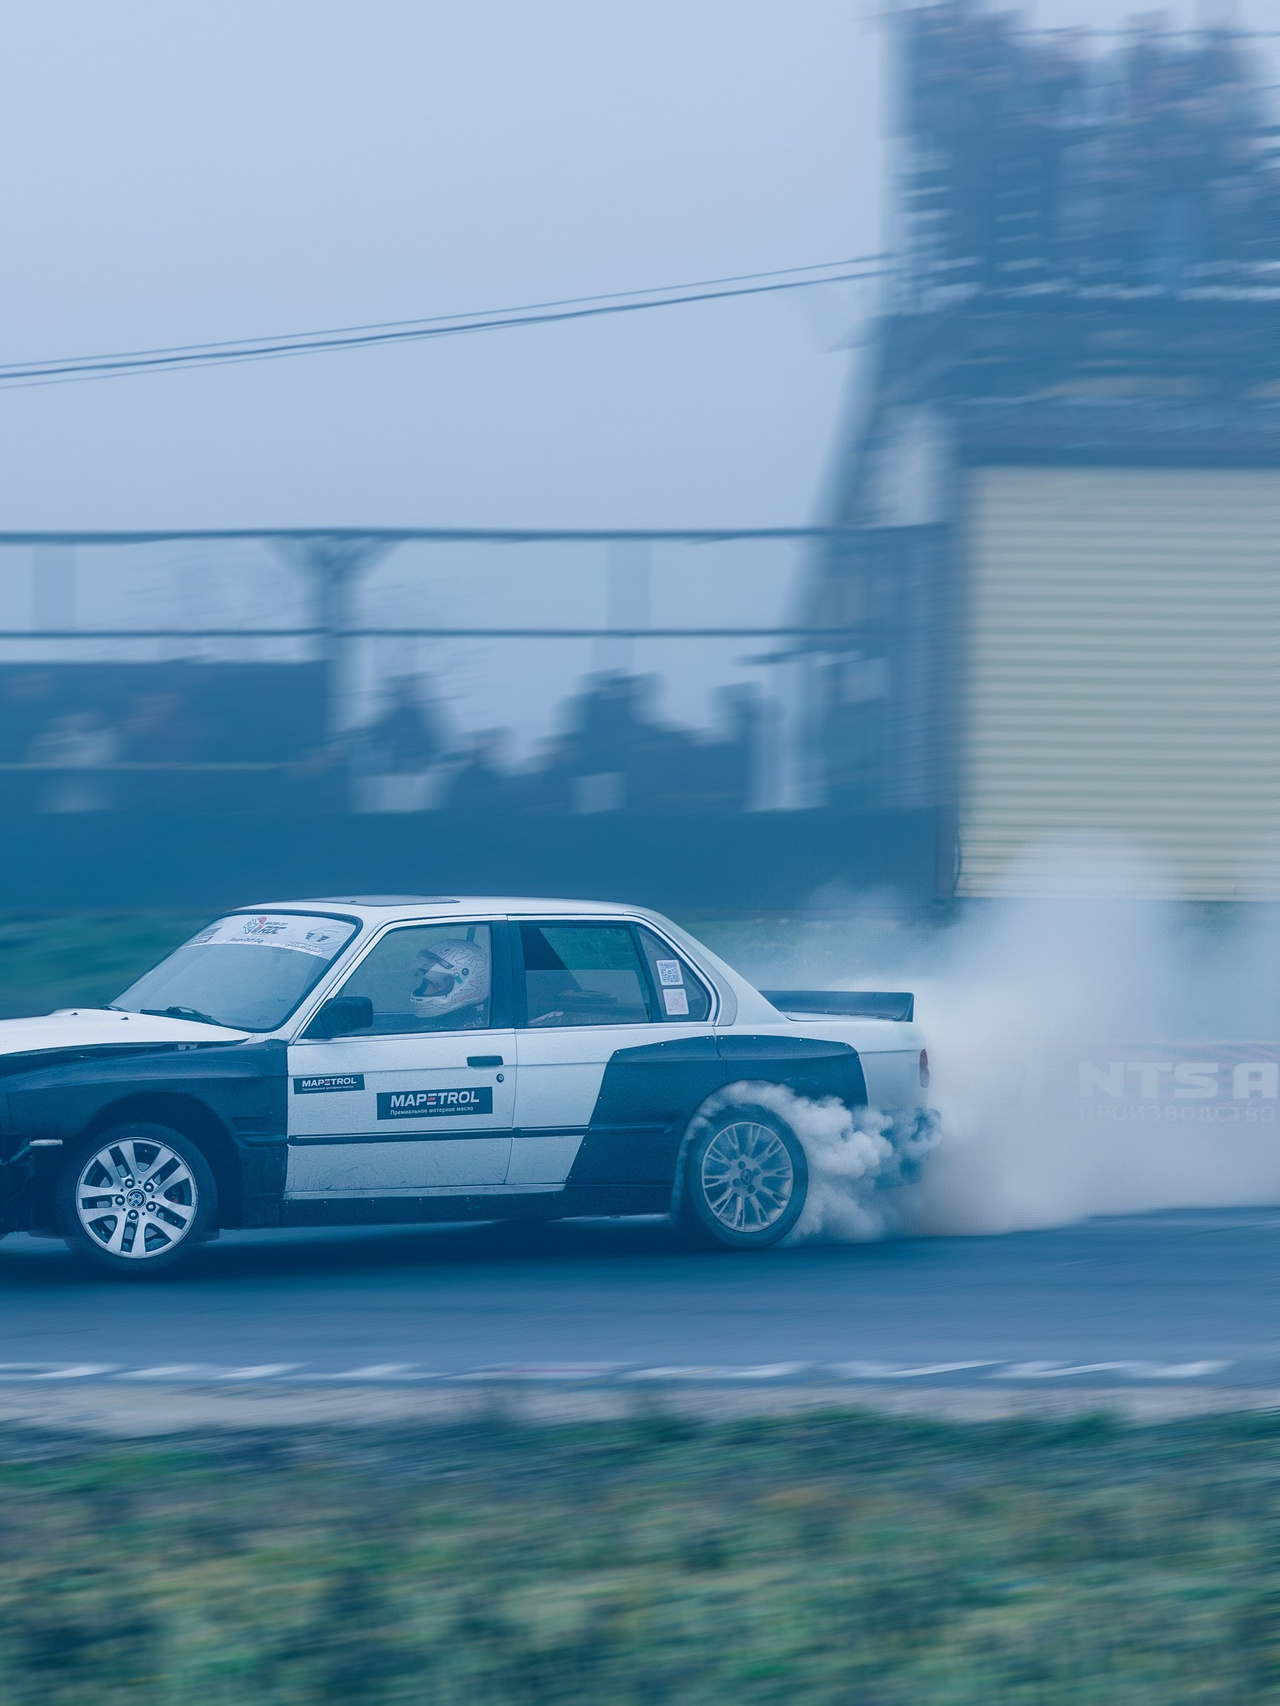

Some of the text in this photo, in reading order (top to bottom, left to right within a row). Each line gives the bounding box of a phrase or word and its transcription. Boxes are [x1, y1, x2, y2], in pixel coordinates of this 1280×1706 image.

[302, 1077, 357, 1087] MAPETROL
[1078, 1061, 1219, 1099] NTS
[390, 1091, 480, 1107] MAPETROL
[1079, 1104, 1276, 1123] ПРОИЗВОДСТВО
